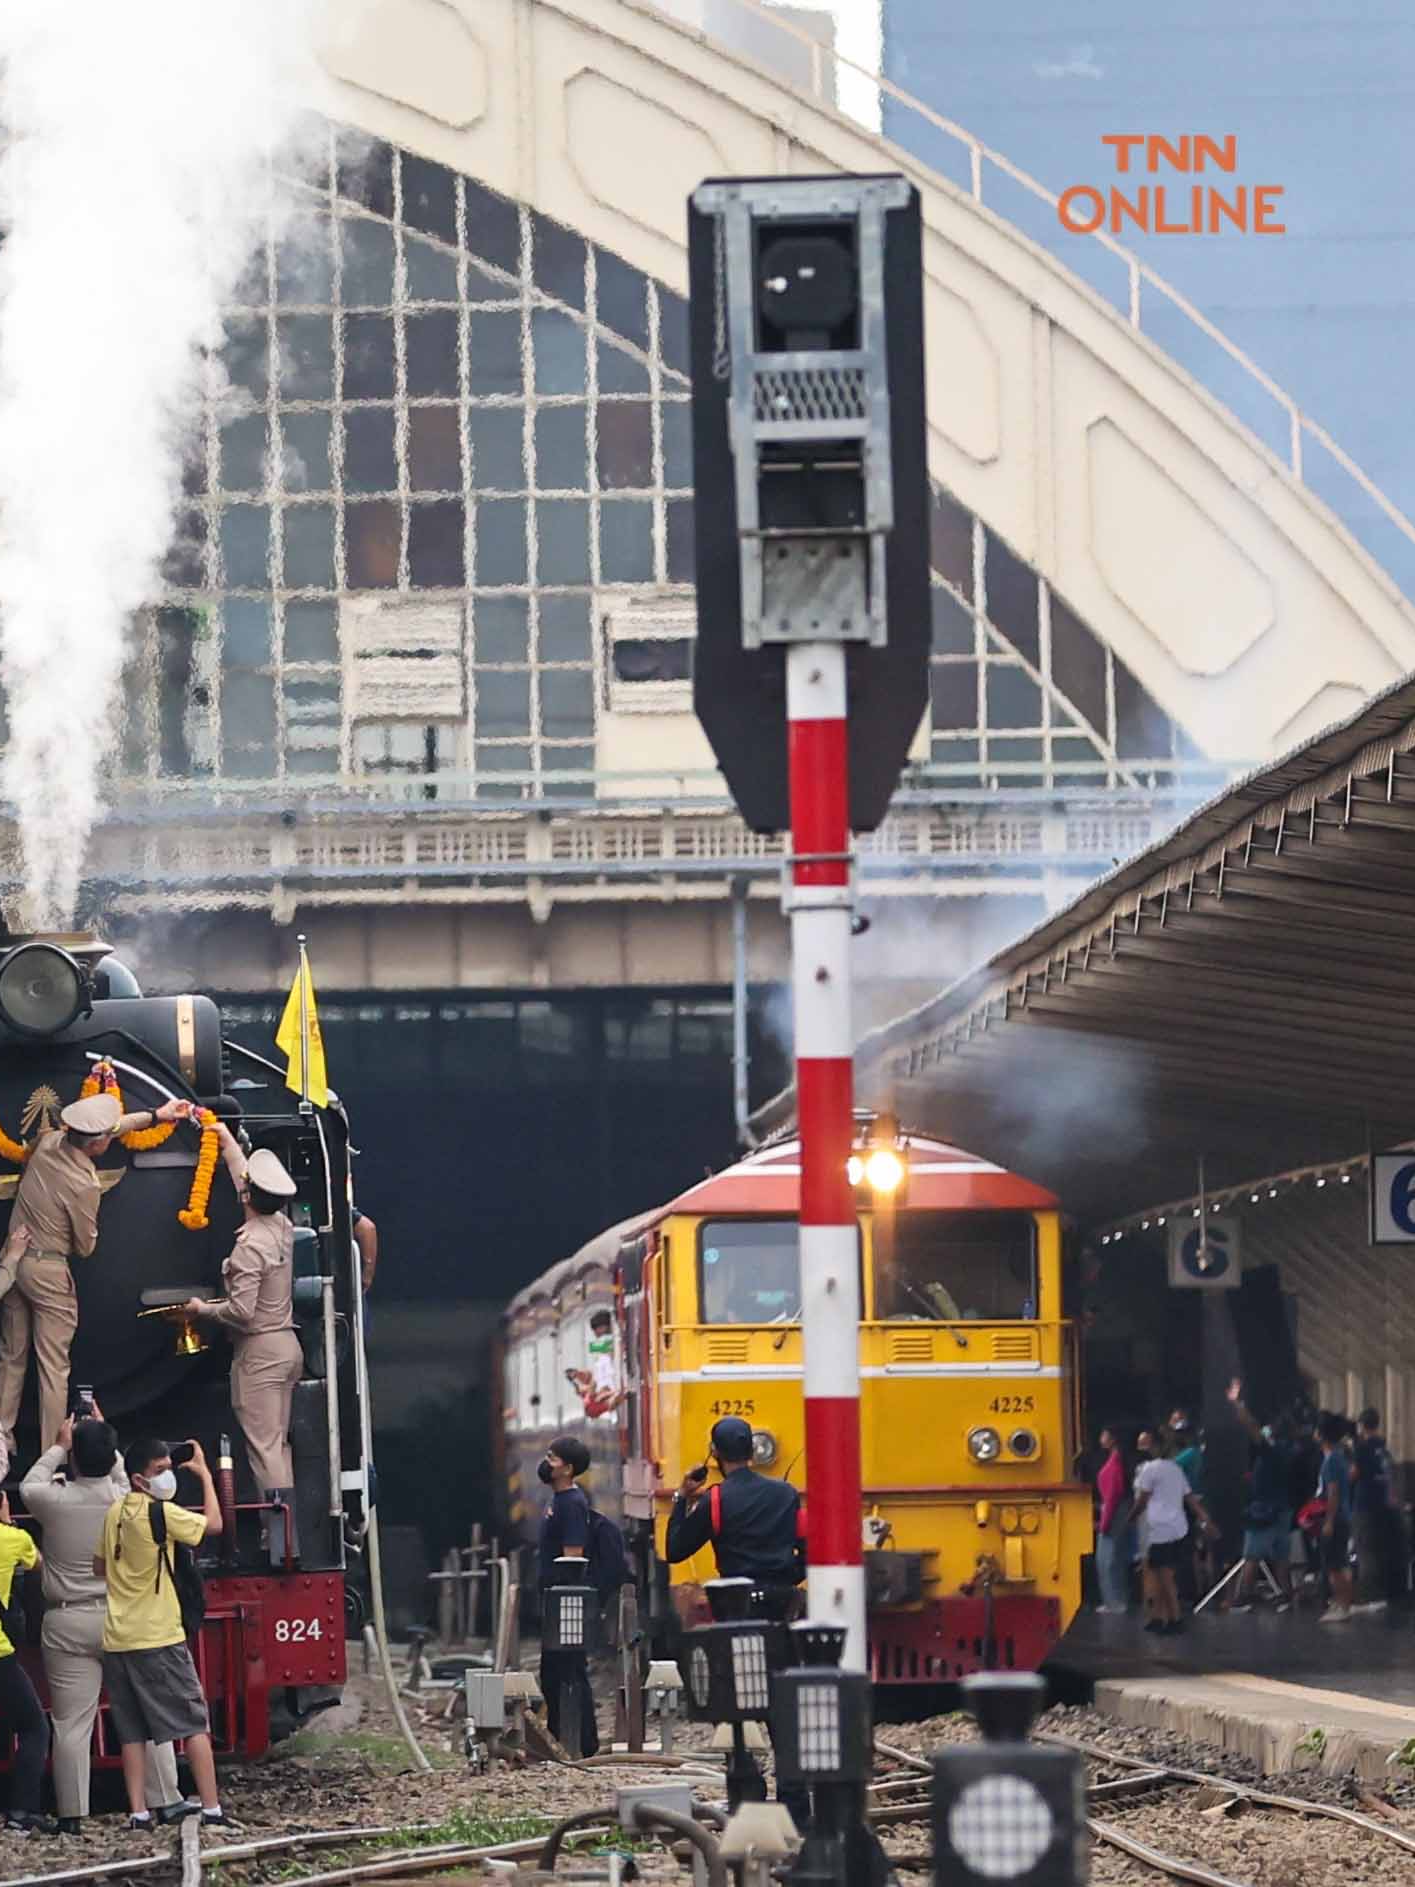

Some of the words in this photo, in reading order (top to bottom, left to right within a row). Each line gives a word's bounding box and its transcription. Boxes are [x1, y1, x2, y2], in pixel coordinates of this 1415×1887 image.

[709, 1399, 755, 1416] 4225
[989, 1395, 1034, 1413] 4225
[275, 1618, 323, 1642] 824
